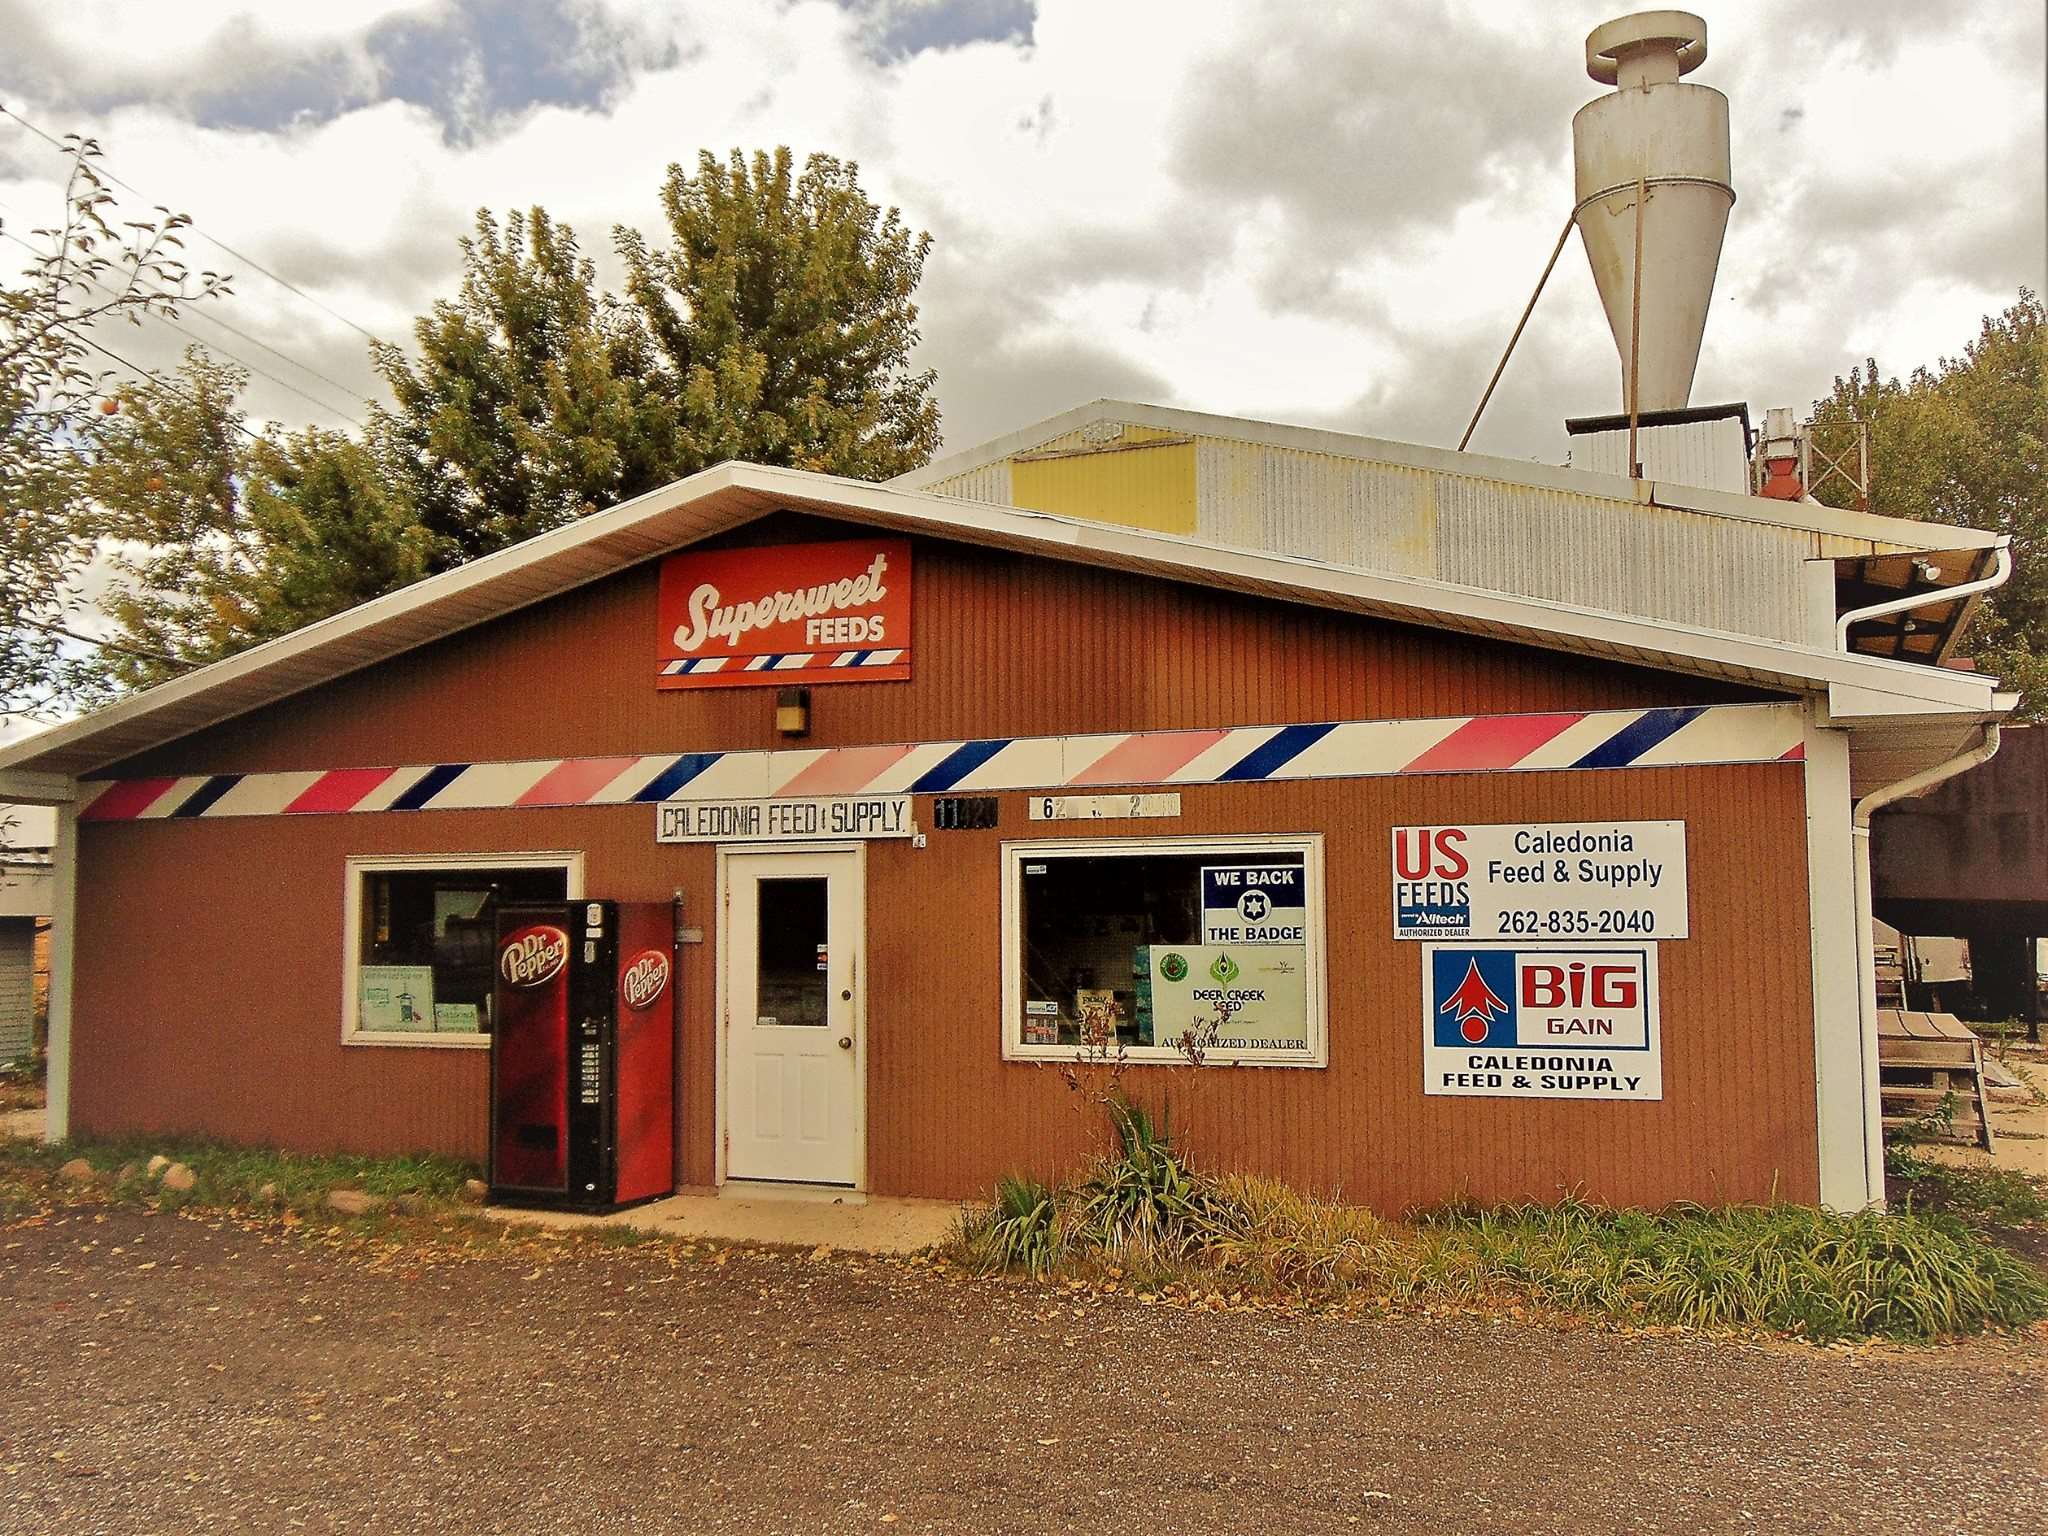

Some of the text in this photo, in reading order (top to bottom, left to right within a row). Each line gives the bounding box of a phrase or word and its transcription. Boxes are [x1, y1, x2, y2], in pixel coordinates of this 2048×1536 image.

[674, 552, 888, 652] Supersweet
[805, 615, 885, 645] FEEDS
[662, 806, 760, 838] CALEDONIA
[768, 803, 817, 834] FEED
[1514, 829, 1634, 854] Caledonia
[1395, 828, 1470, 881] US
[1214, 870, 1295, 886] WE BACK
[1488, 858, 1663, 887] Feed & Supply
[1398, 881, 1470, 907] FEEDS
[1208, 927, 1303, 940] THE BADGE
[1399, 928, 1470, 937] AUTHORIZED DEALER
[1498, 909, 1656, 934] 262-835-2040
[522, 934, 548, 959] Dr
[502, 939, 563, 984] Pepper
[639, 957, 656, 981] Dr
[625, 963, 666, 1004] Pepper
[1193, 990, 1266, 1001] DEER CREEK
[1213, 1001, 1242, 1012] SEED
[1547, 1018, 1613, 1035] GAIN
[1161, 1038, 1305, 1050] AUORIZED DEALER
[1468, 1055, 1614, 1072] CALEDONIA
[1443, 1073, 1641, 1091] FEED & SUPPLY
